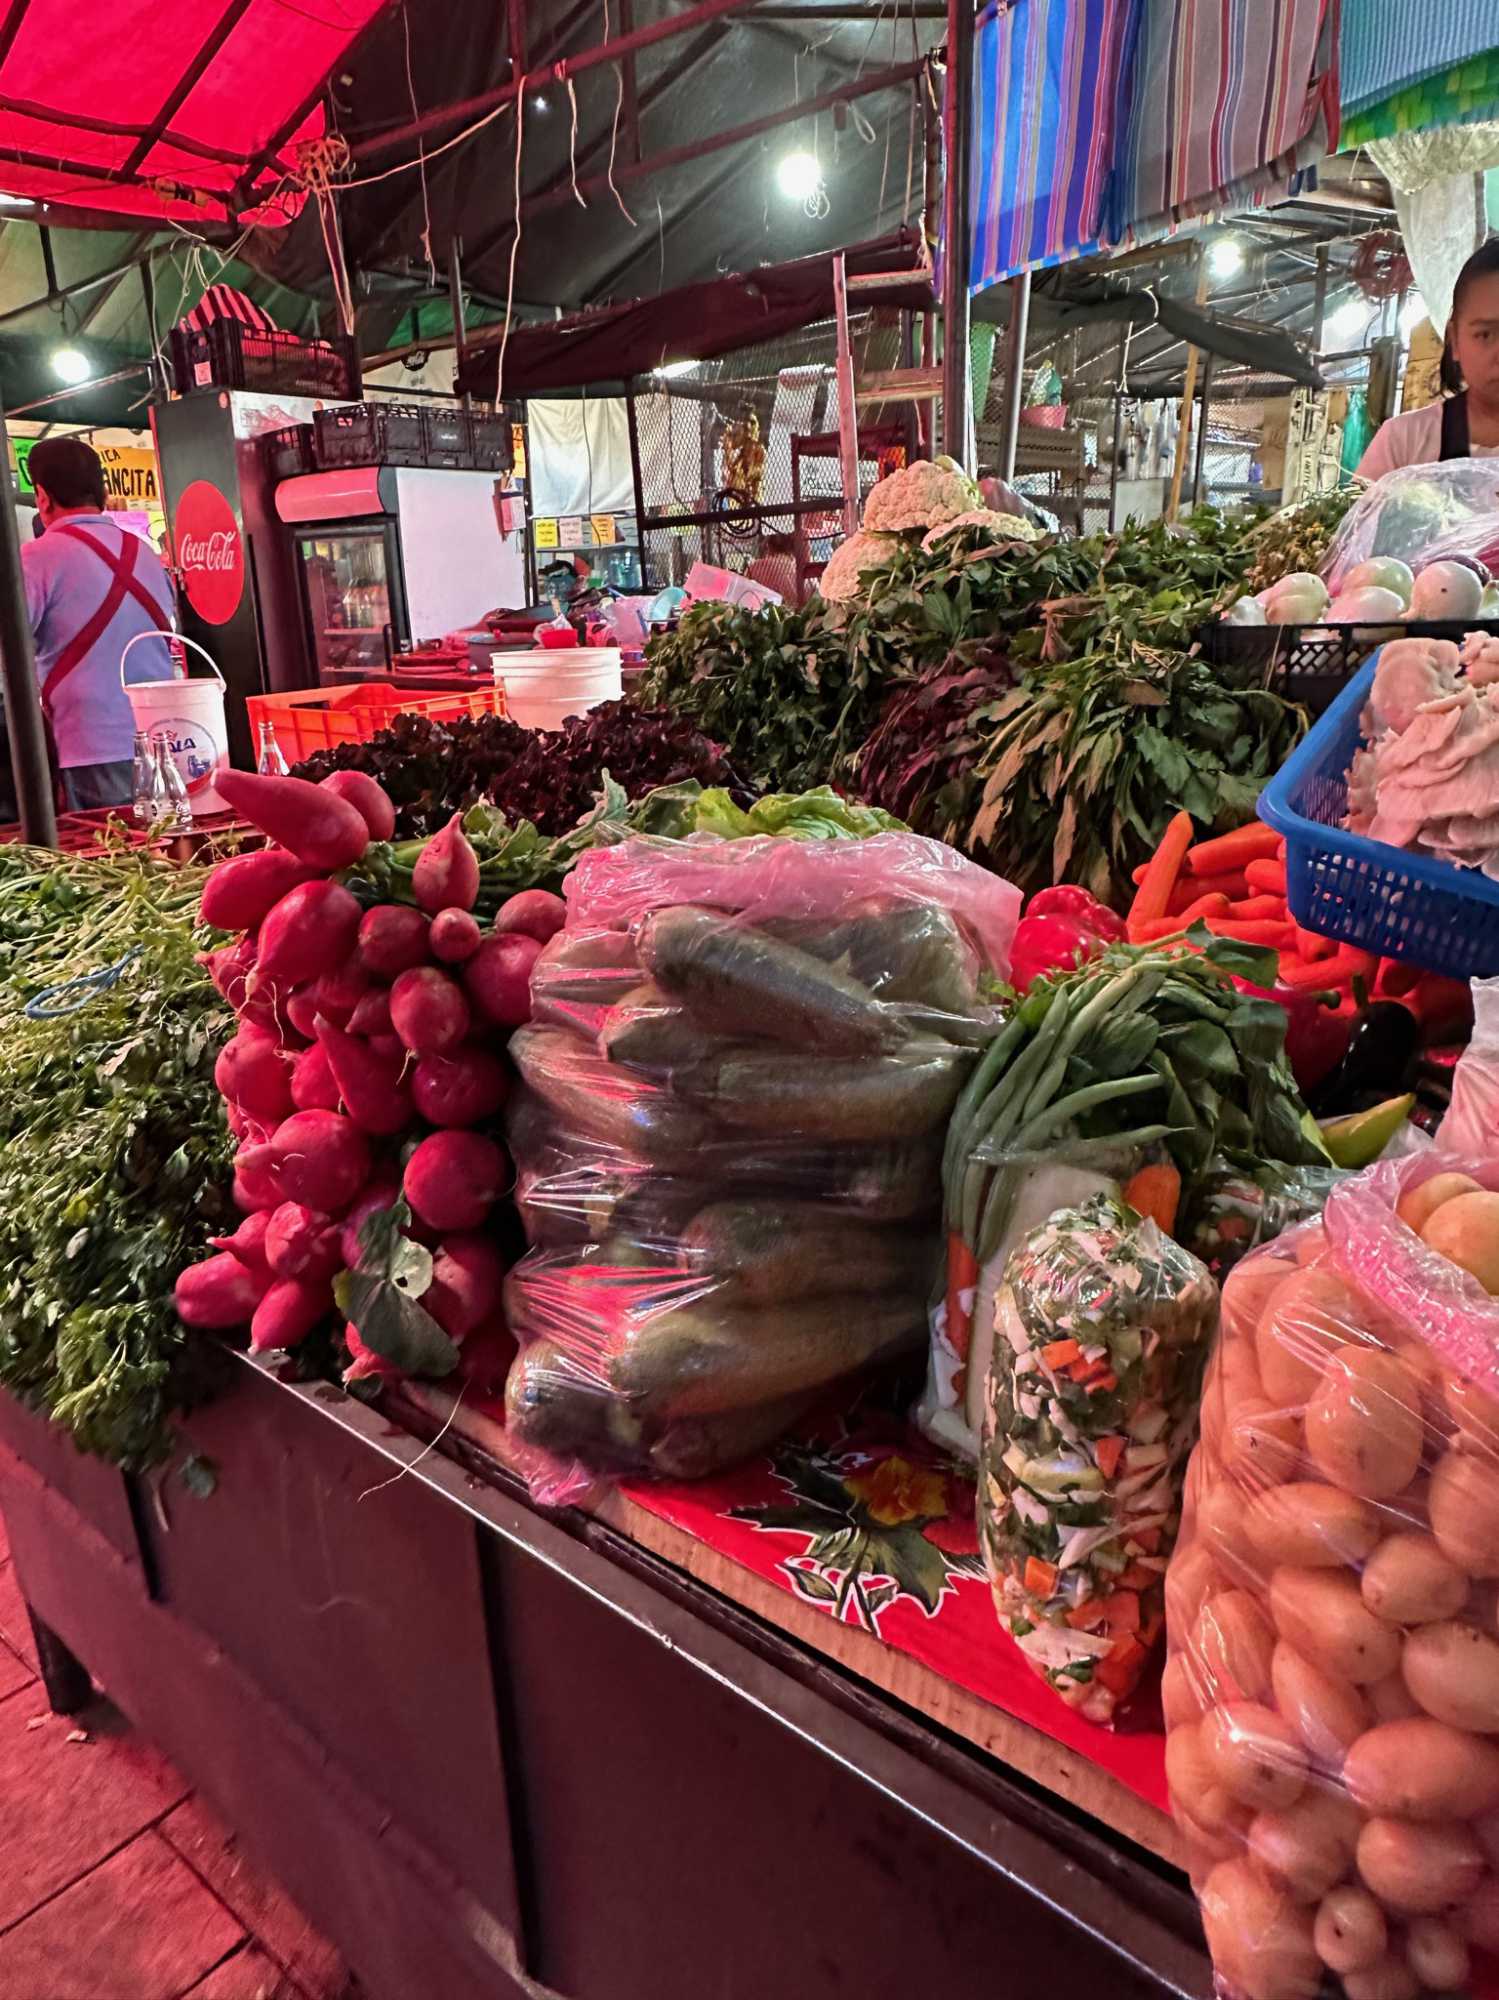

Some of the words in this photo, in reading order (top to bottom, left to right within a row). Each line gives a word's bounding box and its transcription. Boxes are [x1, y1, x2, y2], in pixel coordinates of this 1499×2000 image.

[100, 448, 121, 463] ICA
[103, 467, 156, 497] ANCITA
[180, 530, 237, 572] Coca-Cola
